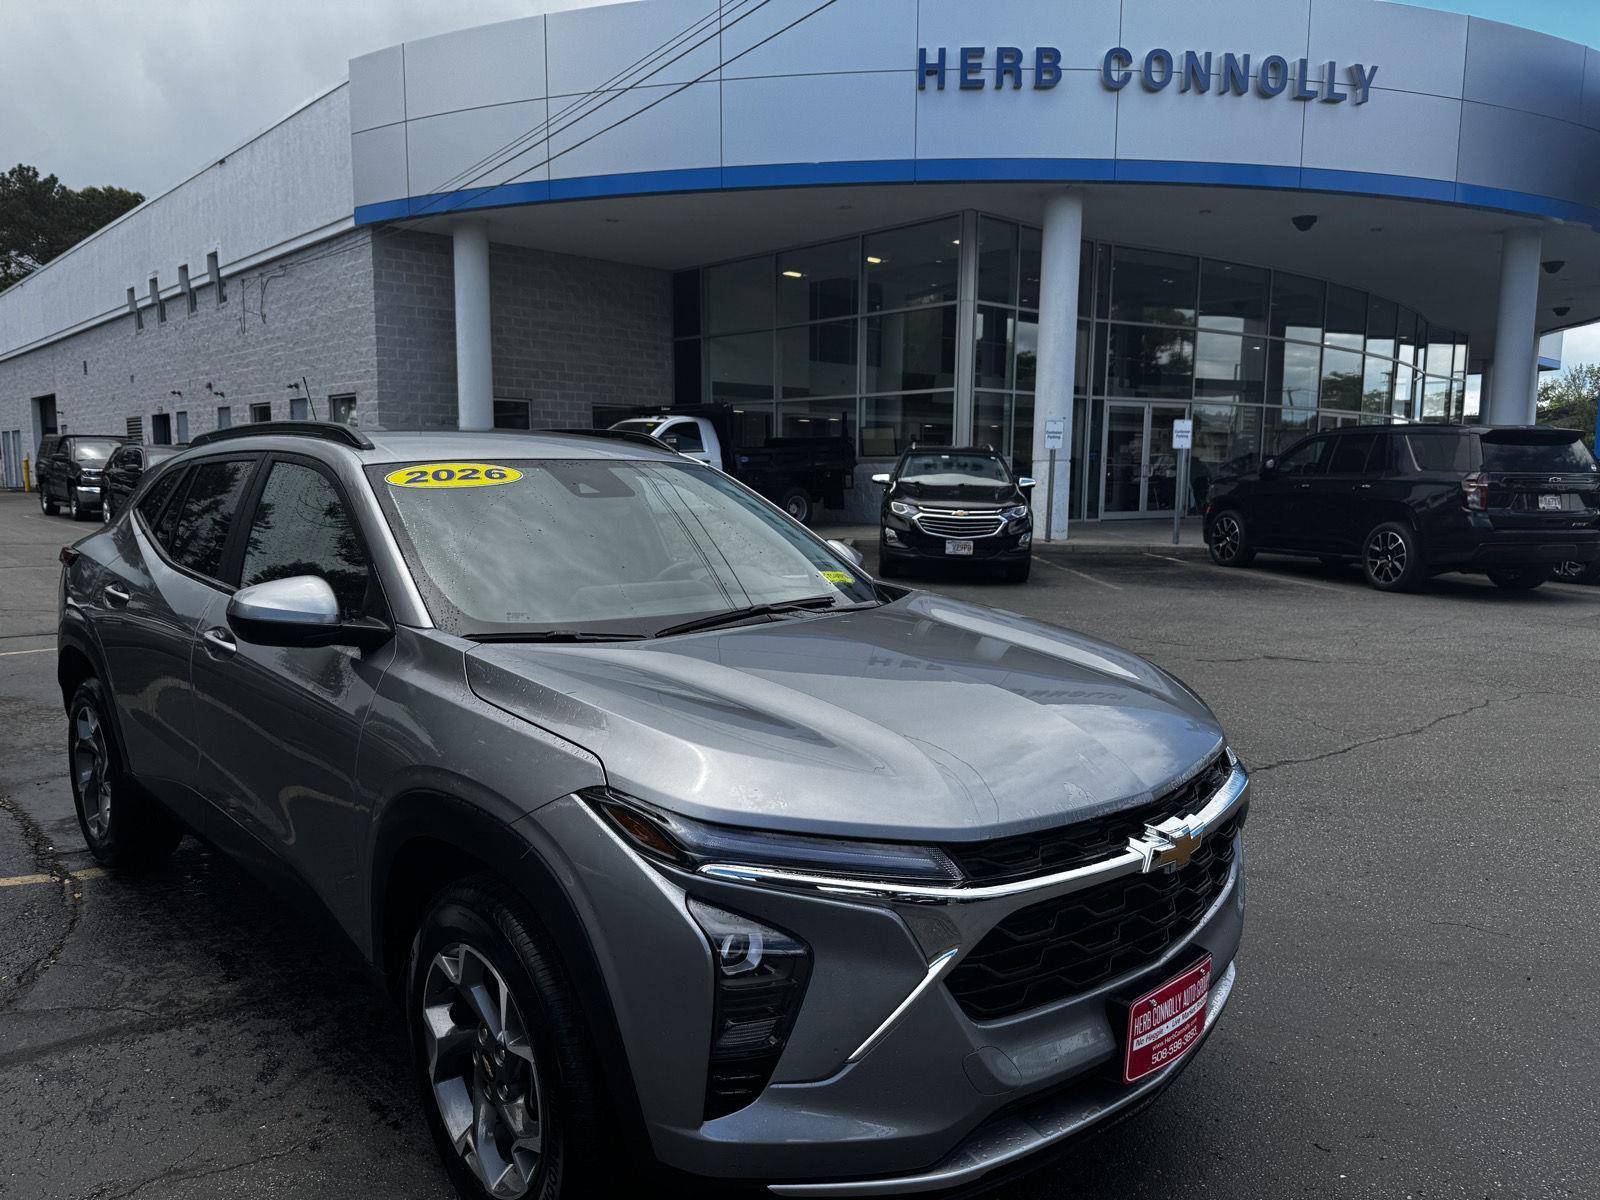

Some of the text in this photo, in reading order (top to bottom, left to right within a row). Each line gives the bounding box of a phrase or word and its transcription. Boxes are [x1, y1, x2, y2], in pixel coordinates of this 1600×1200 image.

[917, 46, 1379, 106] HERB CONNOLLY
[405, 468, 507, 484] 2026
[1134, 1010, 1151, 1037] HERB
[1152, 992, 1182, 1027] CONNOLLY
[1183, 983, 1196, 1008] AUTO
[1135, 1037, 1145, 1048] No
